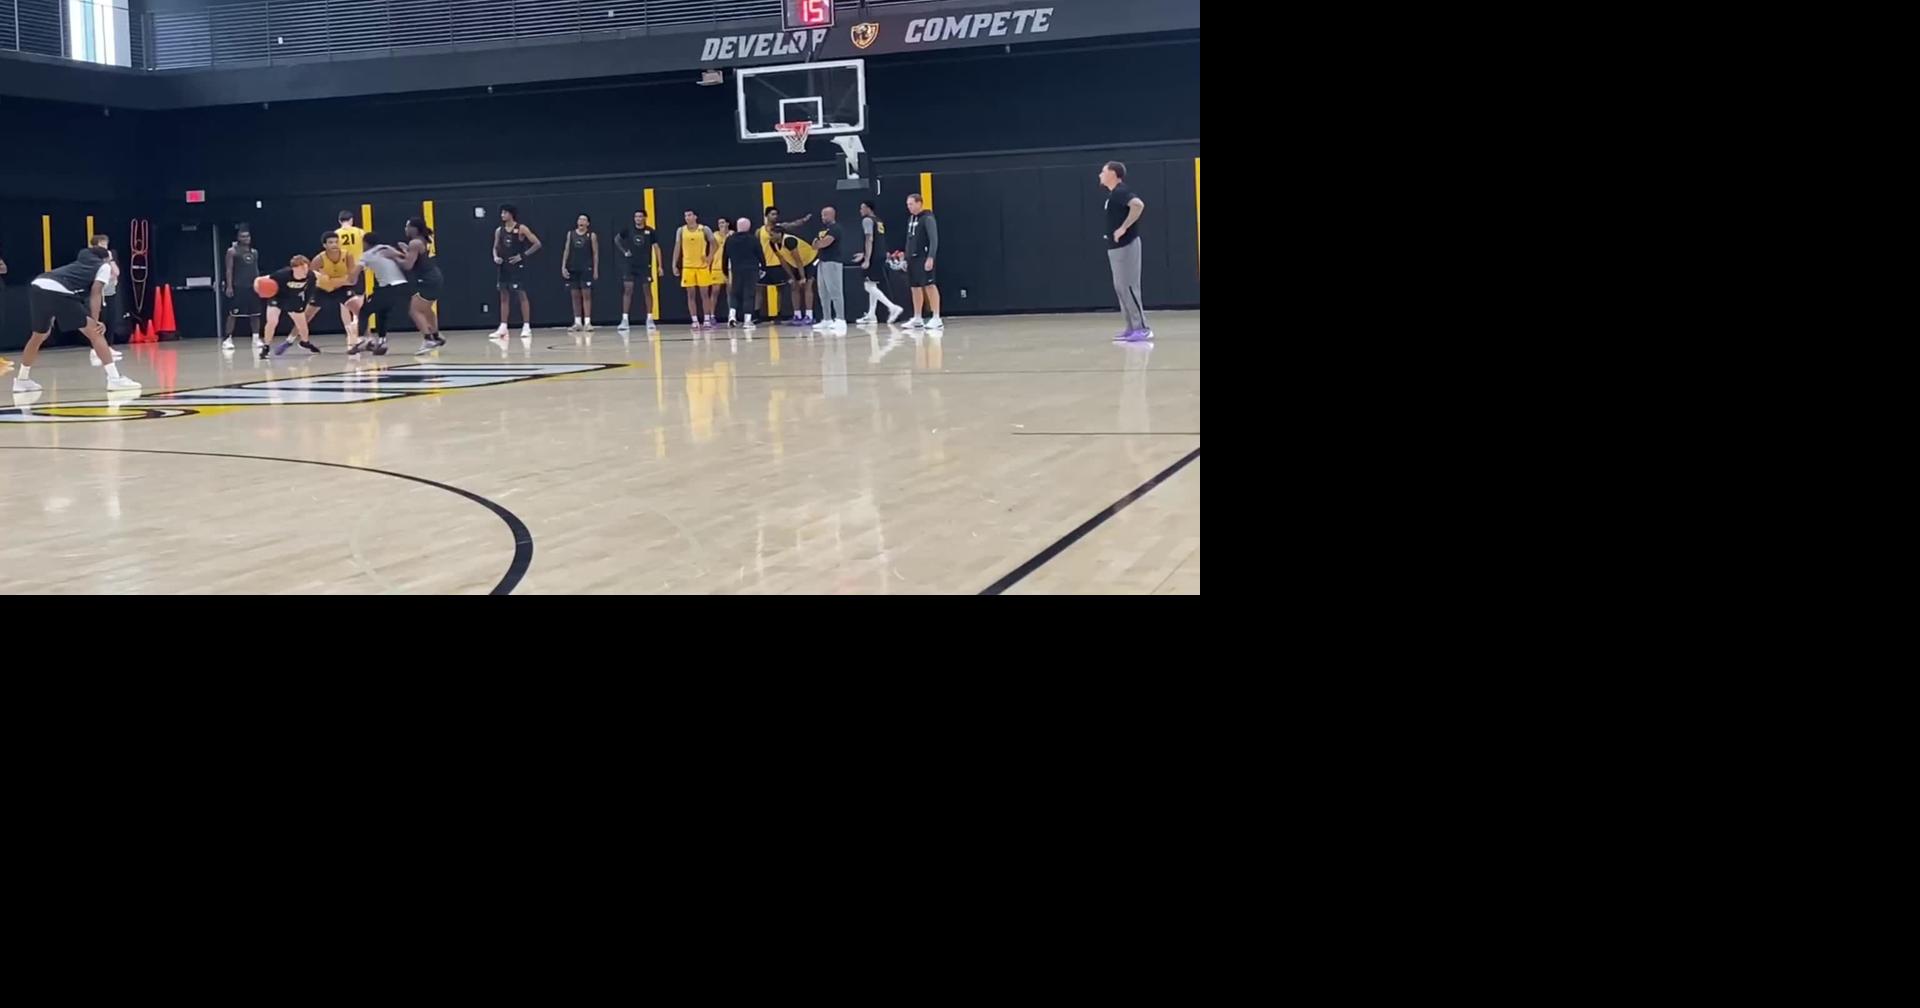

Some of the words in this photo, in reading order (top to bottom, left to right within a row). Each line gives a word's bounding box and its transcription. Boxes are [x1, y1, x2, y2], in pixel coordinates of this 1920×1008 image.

[802, 0, 824, 22] 15
[904, 7, 1054, 44] COMPETE
[341, 233, 355, 246] 21
